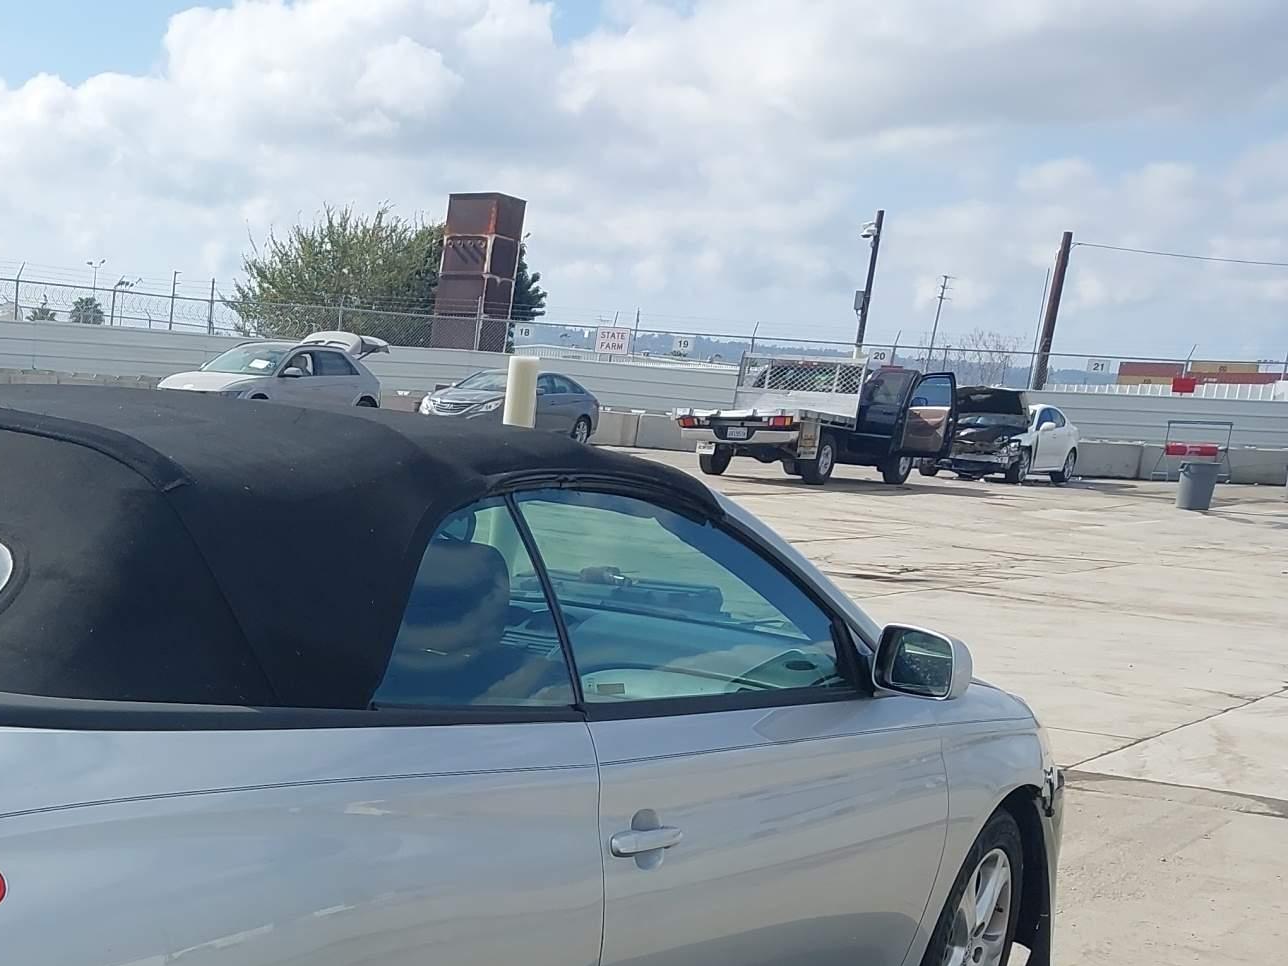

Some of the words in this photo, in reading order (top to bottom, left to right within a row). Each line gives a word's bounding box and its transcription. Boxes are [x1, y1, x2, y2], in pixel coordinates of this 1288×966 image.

[519, 328, 530, 337] 18
[600, 331, 626, 340] STATE
[600, 341, 624, 350] FARM
[678, 339, 689, 348] 19
[873, 351, 886, 361] 20
[1092, 362, 1104, 371] 21
